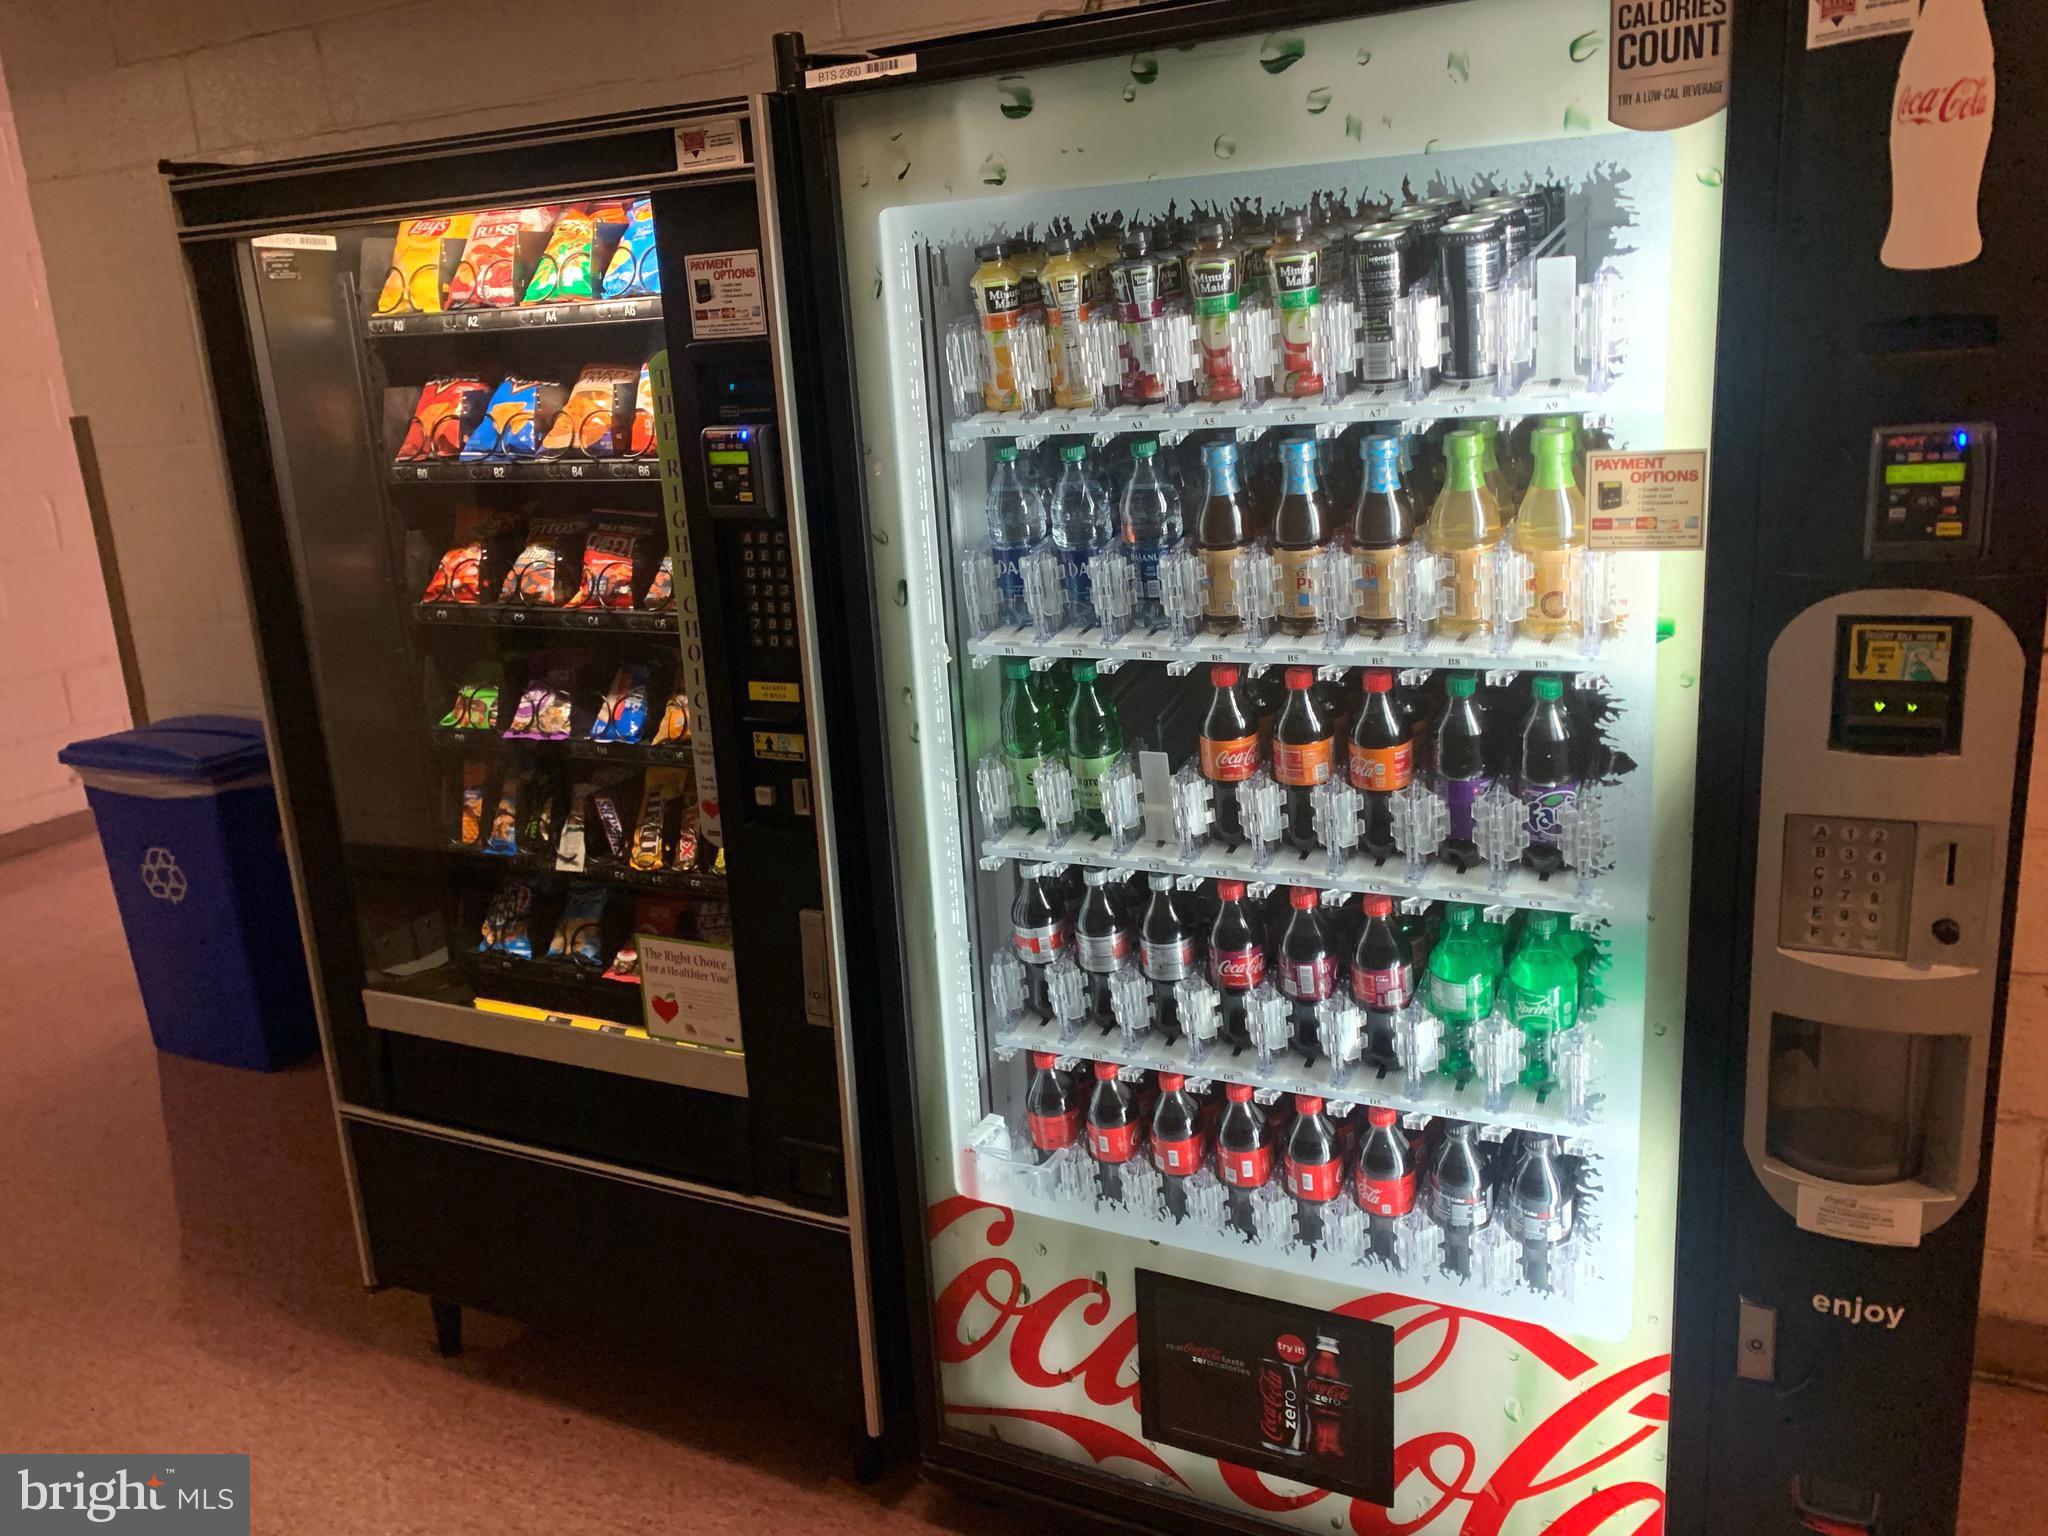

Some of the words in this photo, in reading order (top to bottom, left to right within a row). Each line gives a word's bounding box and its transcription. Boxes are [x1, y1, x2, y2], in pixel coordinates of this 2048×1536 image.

[1618, 0, 1727, 30] CALORIES
[1618, 20, 1727, 70] COUNT
[818, 70, 837, 82] BTS
[839, 66, 861, 79] 2360
[1618, 94, 1632, 106] TRY
[1635, 93, 1641, 104] A
[1644, 87, 1678, 103] LOW-CAL
[1682, 80, 1723, 98] BEVERAGE
[690, 258, 733, 271] PAYMENT
[714, 267, 756, 281] OPTIONS
[989, 286, 1020, 300] Minut
[545, 310, 557, 323] A4
[624, 305, 636, 317] A6
[467, 316, 478, 328] A2
[1369, 409, 1381, 418] A7
[1452, 405, 1465, 415] A7
[1203, 417, 1215, 426] A5
[1283, 414, 1296, 423] A5
[1594, 457, 1666, 471] PAYMENT
[493, 467, 505, 478] B2
[571, 466, 583, 477] B4
[1630, 469, 1699, 484] OPTIONS
[1211, 654, 1223, 662] B5
[1287, 654, 1299, 663] B5
[1371, 657, 1384, 666] B5
[645, 947, 662, 959] The
[664, 950, 691, 966] Right
[645, 962, 658, 973] for
[667, 965, 708, 981] Healthier
[1516, 1001, 1552, 1016] Sprite
[1812, 1294, 1906, 1329] enjoy
[1277, 1341, 1292, 1353] try
[1294, 1344, 1306, 1356] it!
[1221, 1356, 1245, 1368] taste
[1315, 1393, 1341, 1407] zero
[1285, 1390, 1297, 1430] zero
